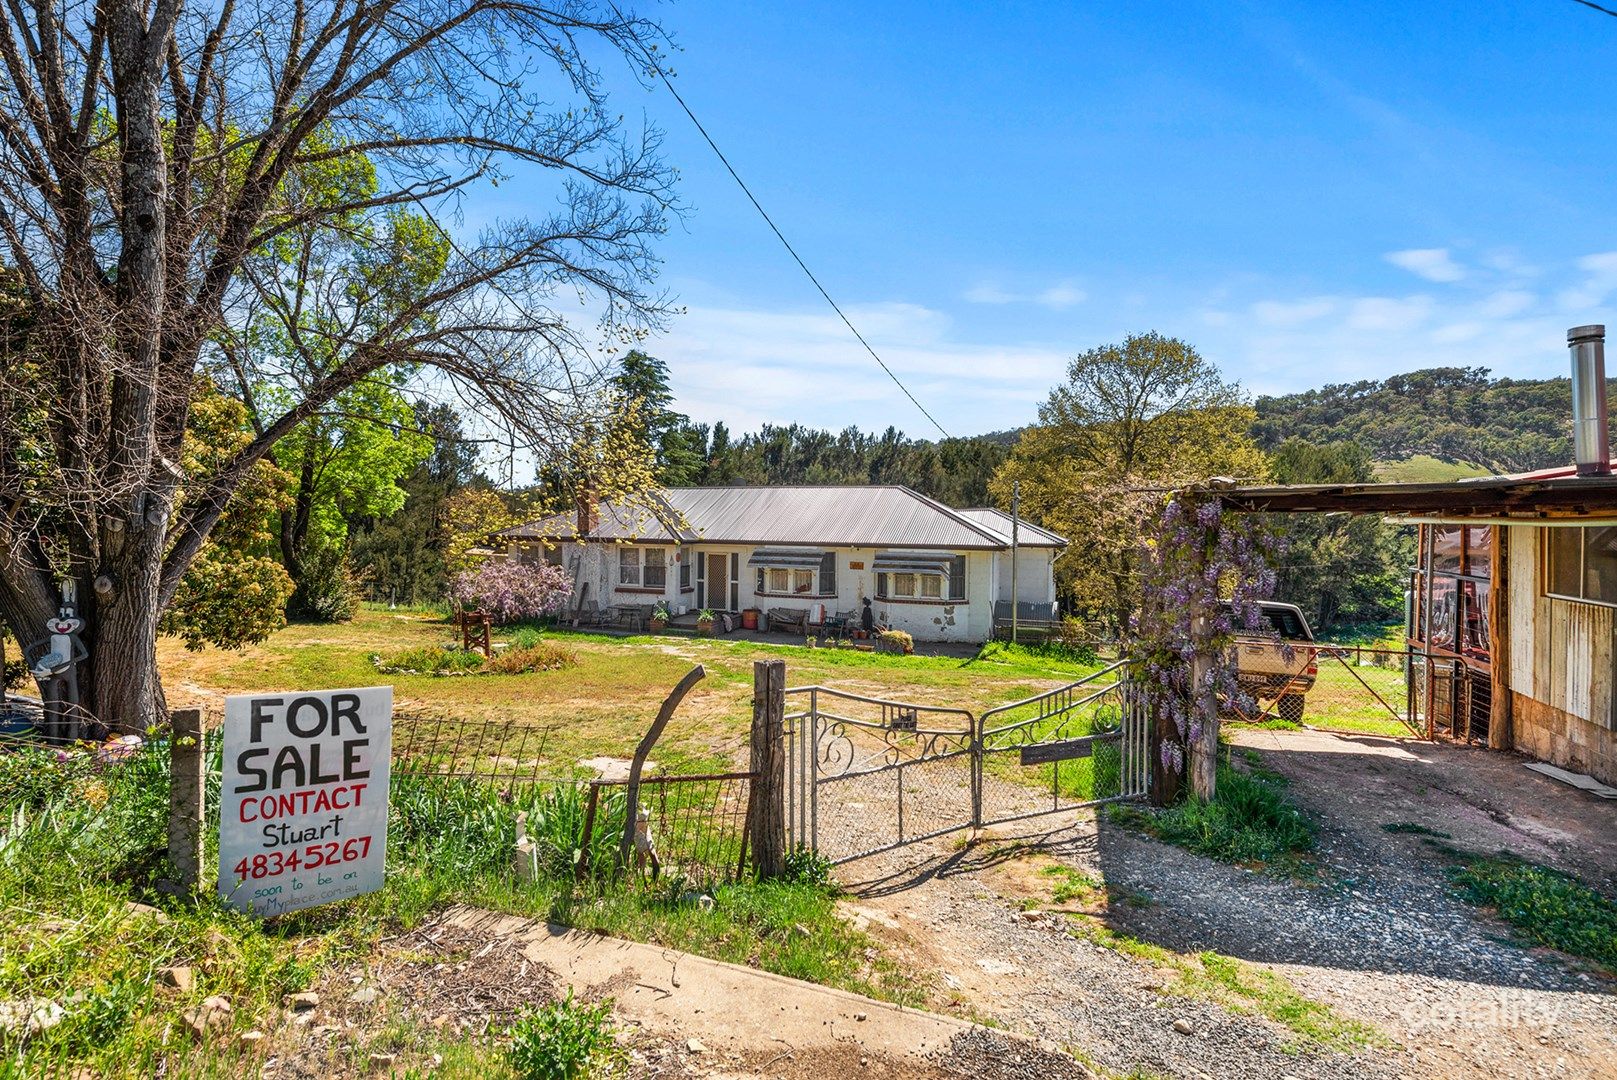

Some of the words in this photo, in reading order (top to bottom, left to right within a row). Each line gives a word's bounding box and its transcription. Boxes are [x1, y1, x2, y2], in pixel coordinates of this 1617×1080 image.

[250, 693, 367, 743] FOR
[234, 738, 370, 794] SALE
[239, 783, 368, 823] CONTACT
[262, 814, 344, 848] Stuart
[233, 835, 372, 881] 48345267
[254, 885, 283, 899] soon
[291, 877, 304, 891] to
[317, 871, 333, 886] be
[343, 870, 358, 880] on
